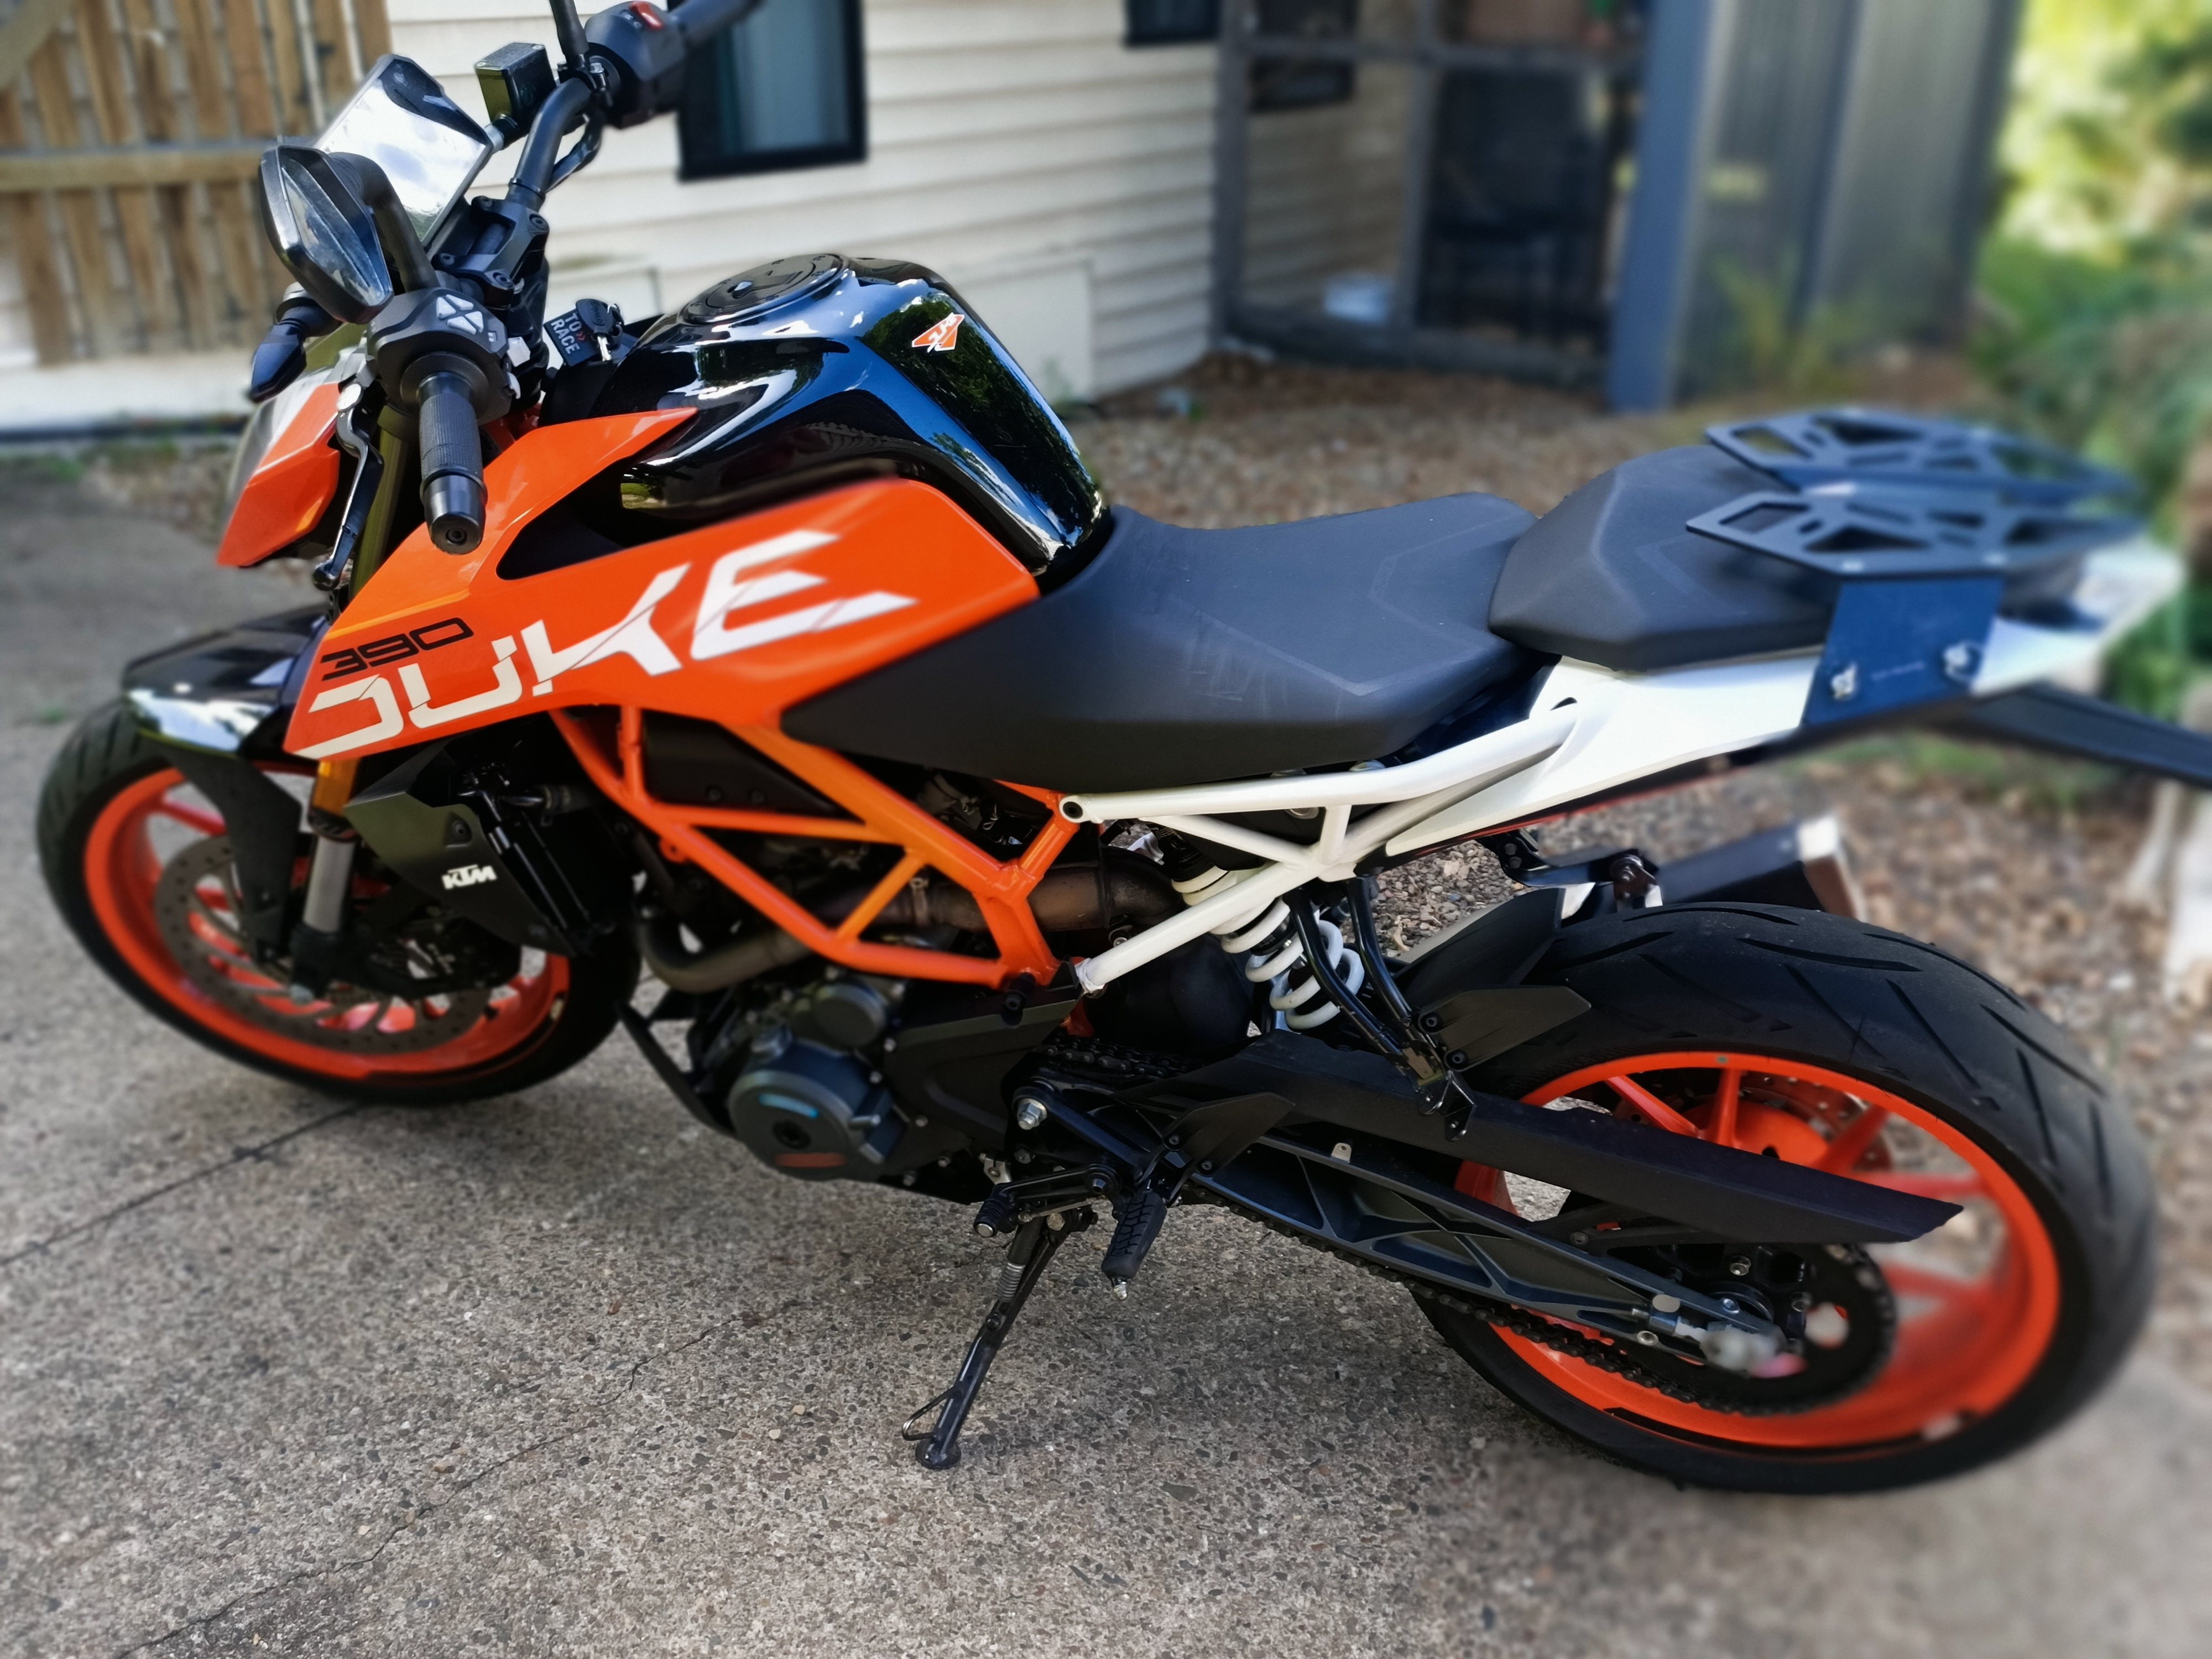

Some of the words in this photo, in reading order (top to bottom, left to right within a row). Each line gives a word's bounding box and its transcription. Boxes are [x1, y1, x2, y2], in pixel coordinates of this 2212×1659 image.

[551, 319, 580, 354] RACE
[565, 313, 582, 332] TO
[291, 529, 919, 759] DUKE
[321, 617, 474, 681] 390
[442, 864, 497, 889] KTM
